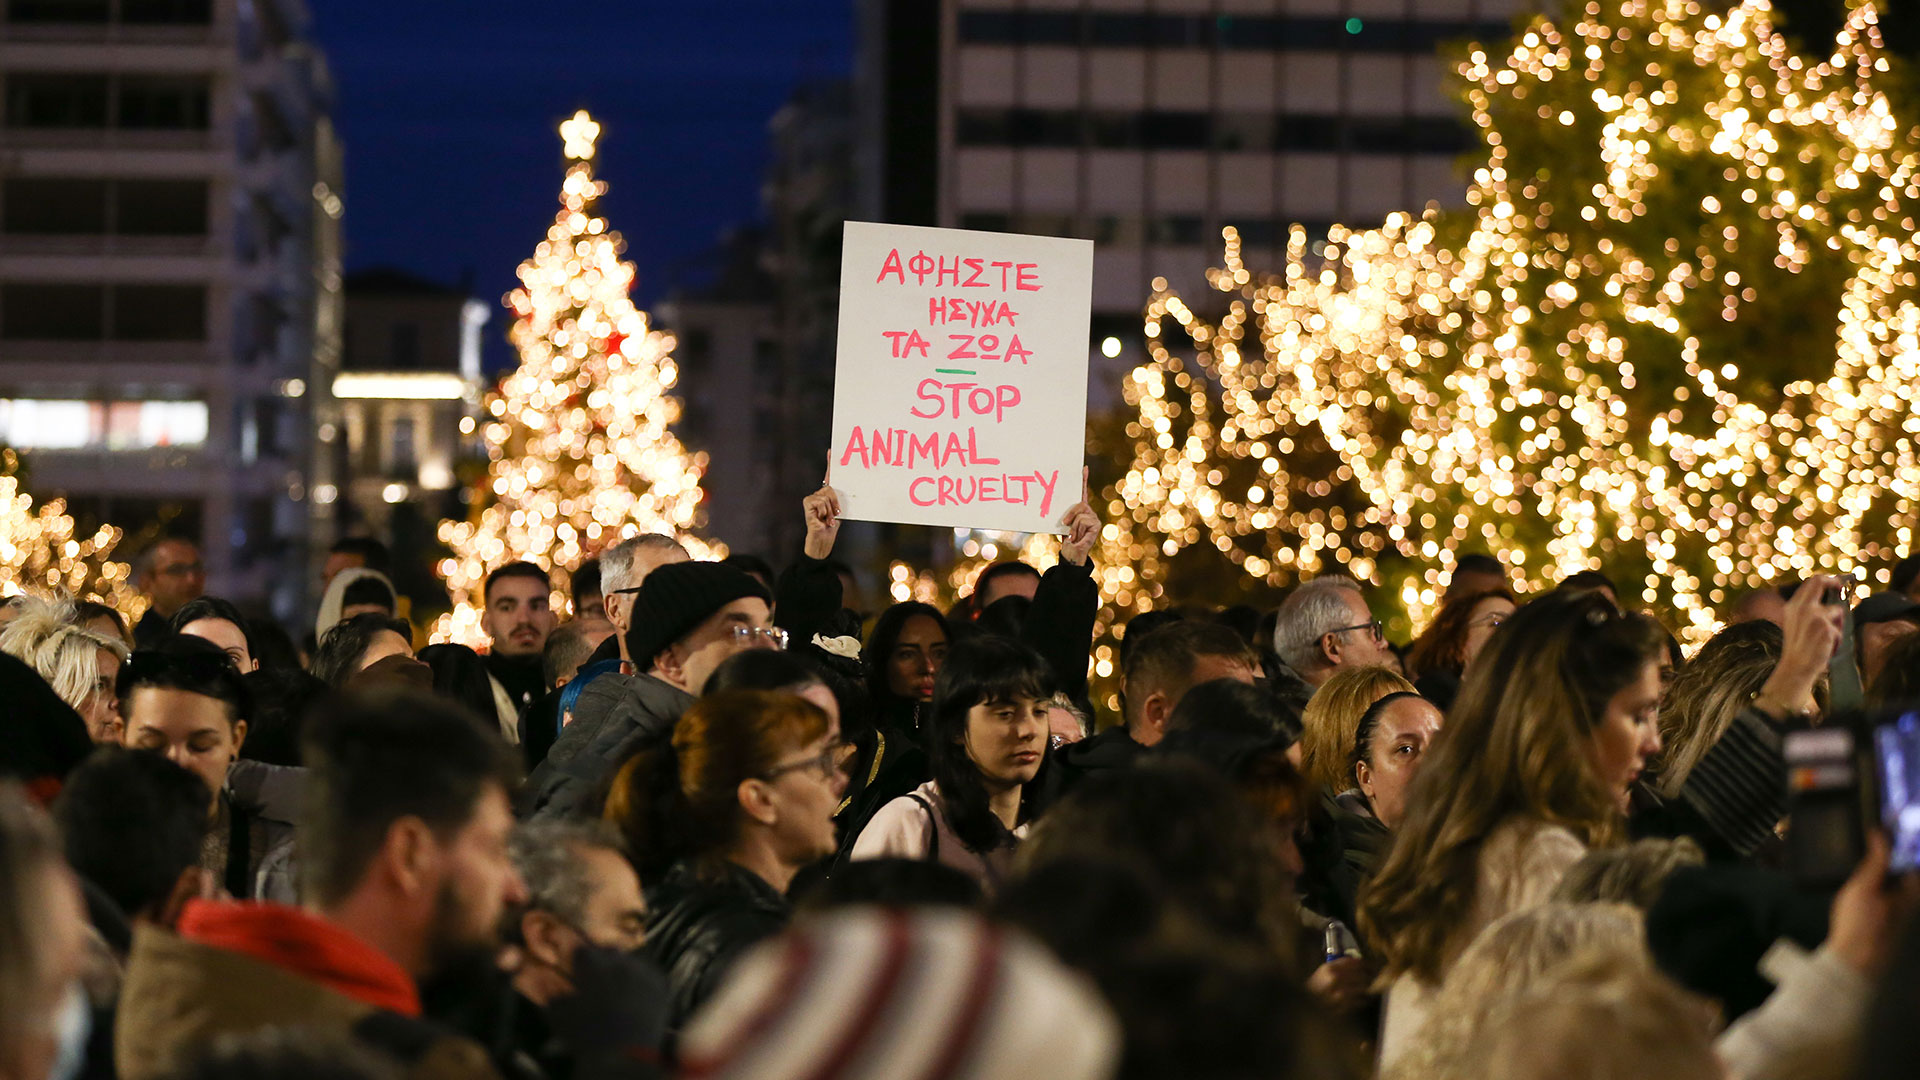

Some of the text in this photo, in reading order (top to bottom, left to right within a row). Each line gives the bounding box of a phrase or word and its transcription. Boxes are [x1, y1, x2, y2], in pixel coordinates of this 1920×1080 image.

[876, 248, 1043, 292] ΑΦΗΣΤΕ
[929, 296, 1020, 328] ΗΣΥΧΑ
[882, 328, 1034, 365] ΤΑ ΖΩΑ
[910, 378, 1021, 424] STOP
[840, 425, 1000, 470] ANIMAL
[909, 470, 1059, 518] CRUELTY
